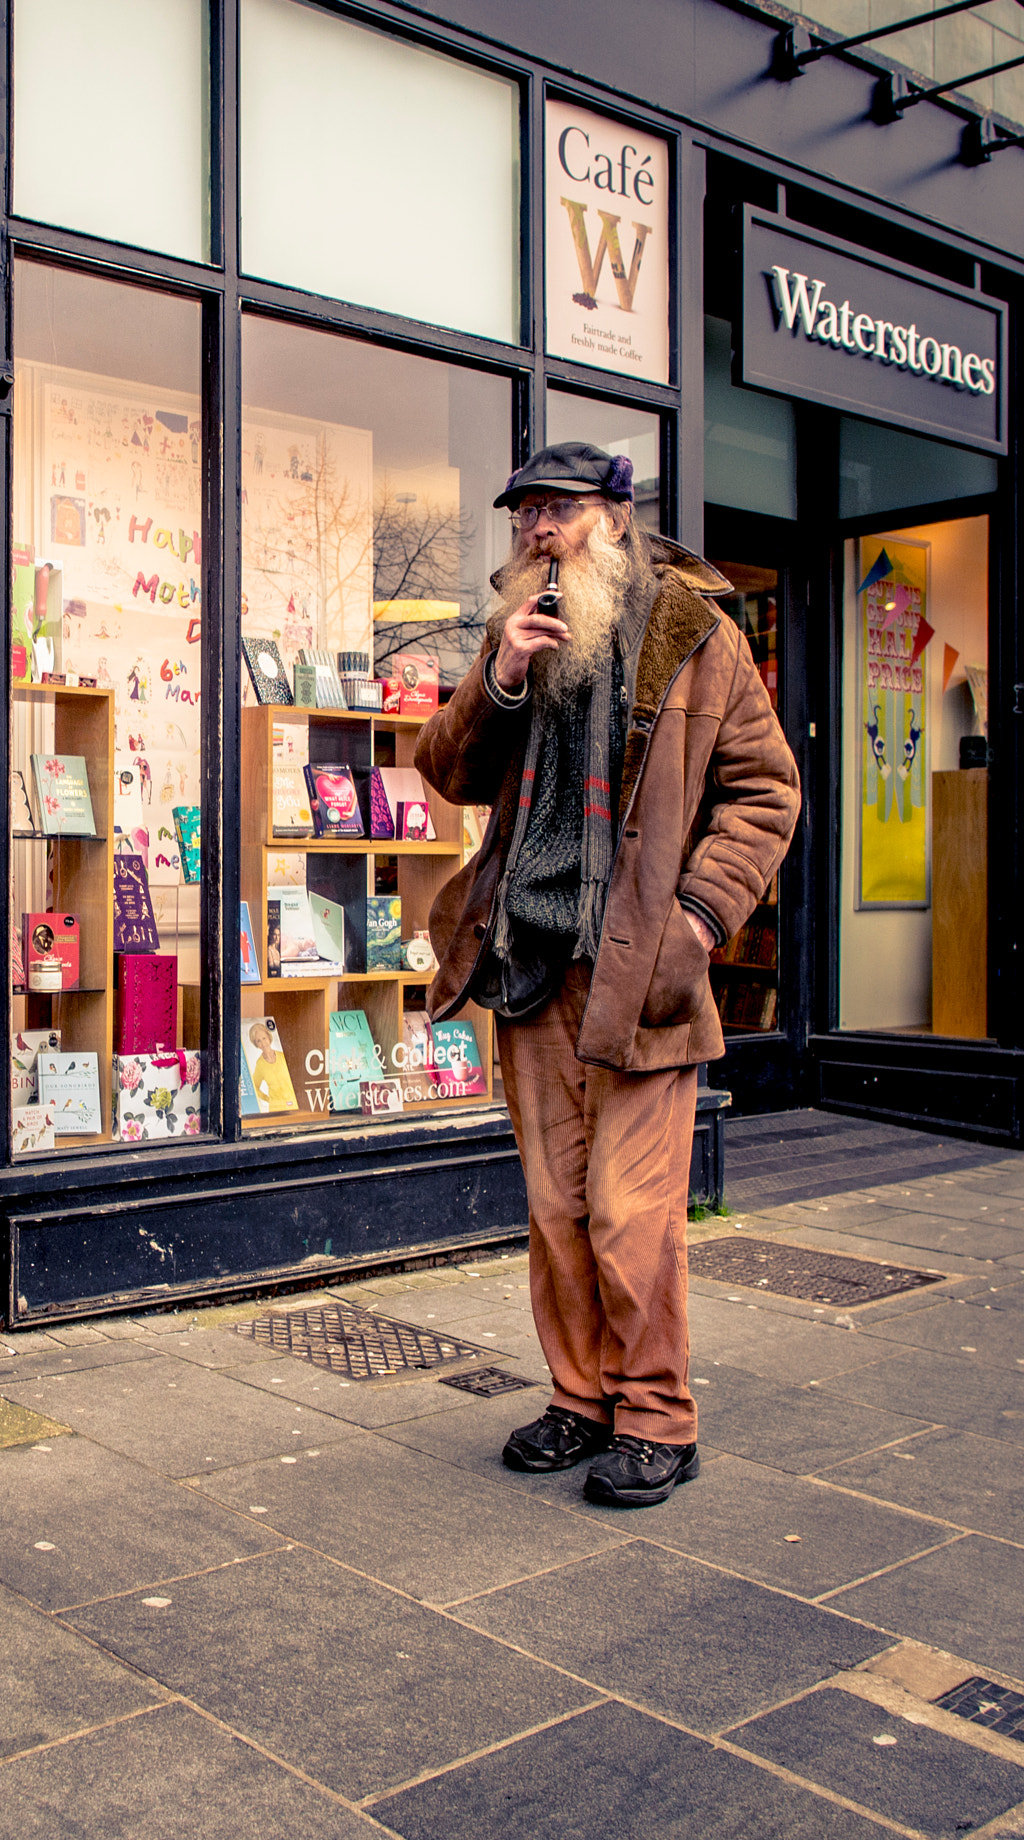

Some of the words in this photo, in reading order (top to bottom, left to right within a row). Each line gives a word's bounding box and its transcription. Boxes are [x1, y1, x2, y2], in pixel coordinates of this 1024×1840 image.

[558, 126, 655, 206] Café
[560, 196, 653, 313] W
[583, 322, 616, 341] Fairtrade
[617, 335, 632, 346] and
[771, 264, 995, 395] Waterstones
[571, 333, 595, 352] freshly
[597, 343, 618, 356] made
[619, 346, 644, 362] Coffee
[867, 628, 917, 660] HAL
[160, 659, 188, 681] 6th
[867, 662, 923, 693] PRICE
[378, 917, 398, 930] Gogh
[305, 1047, 365, 1077] Click
[371, 1044, 387, 1070] &
[391, 1040, 468, 1069] Collect
[305, 1081, 468, 1112] Waterstones.com
